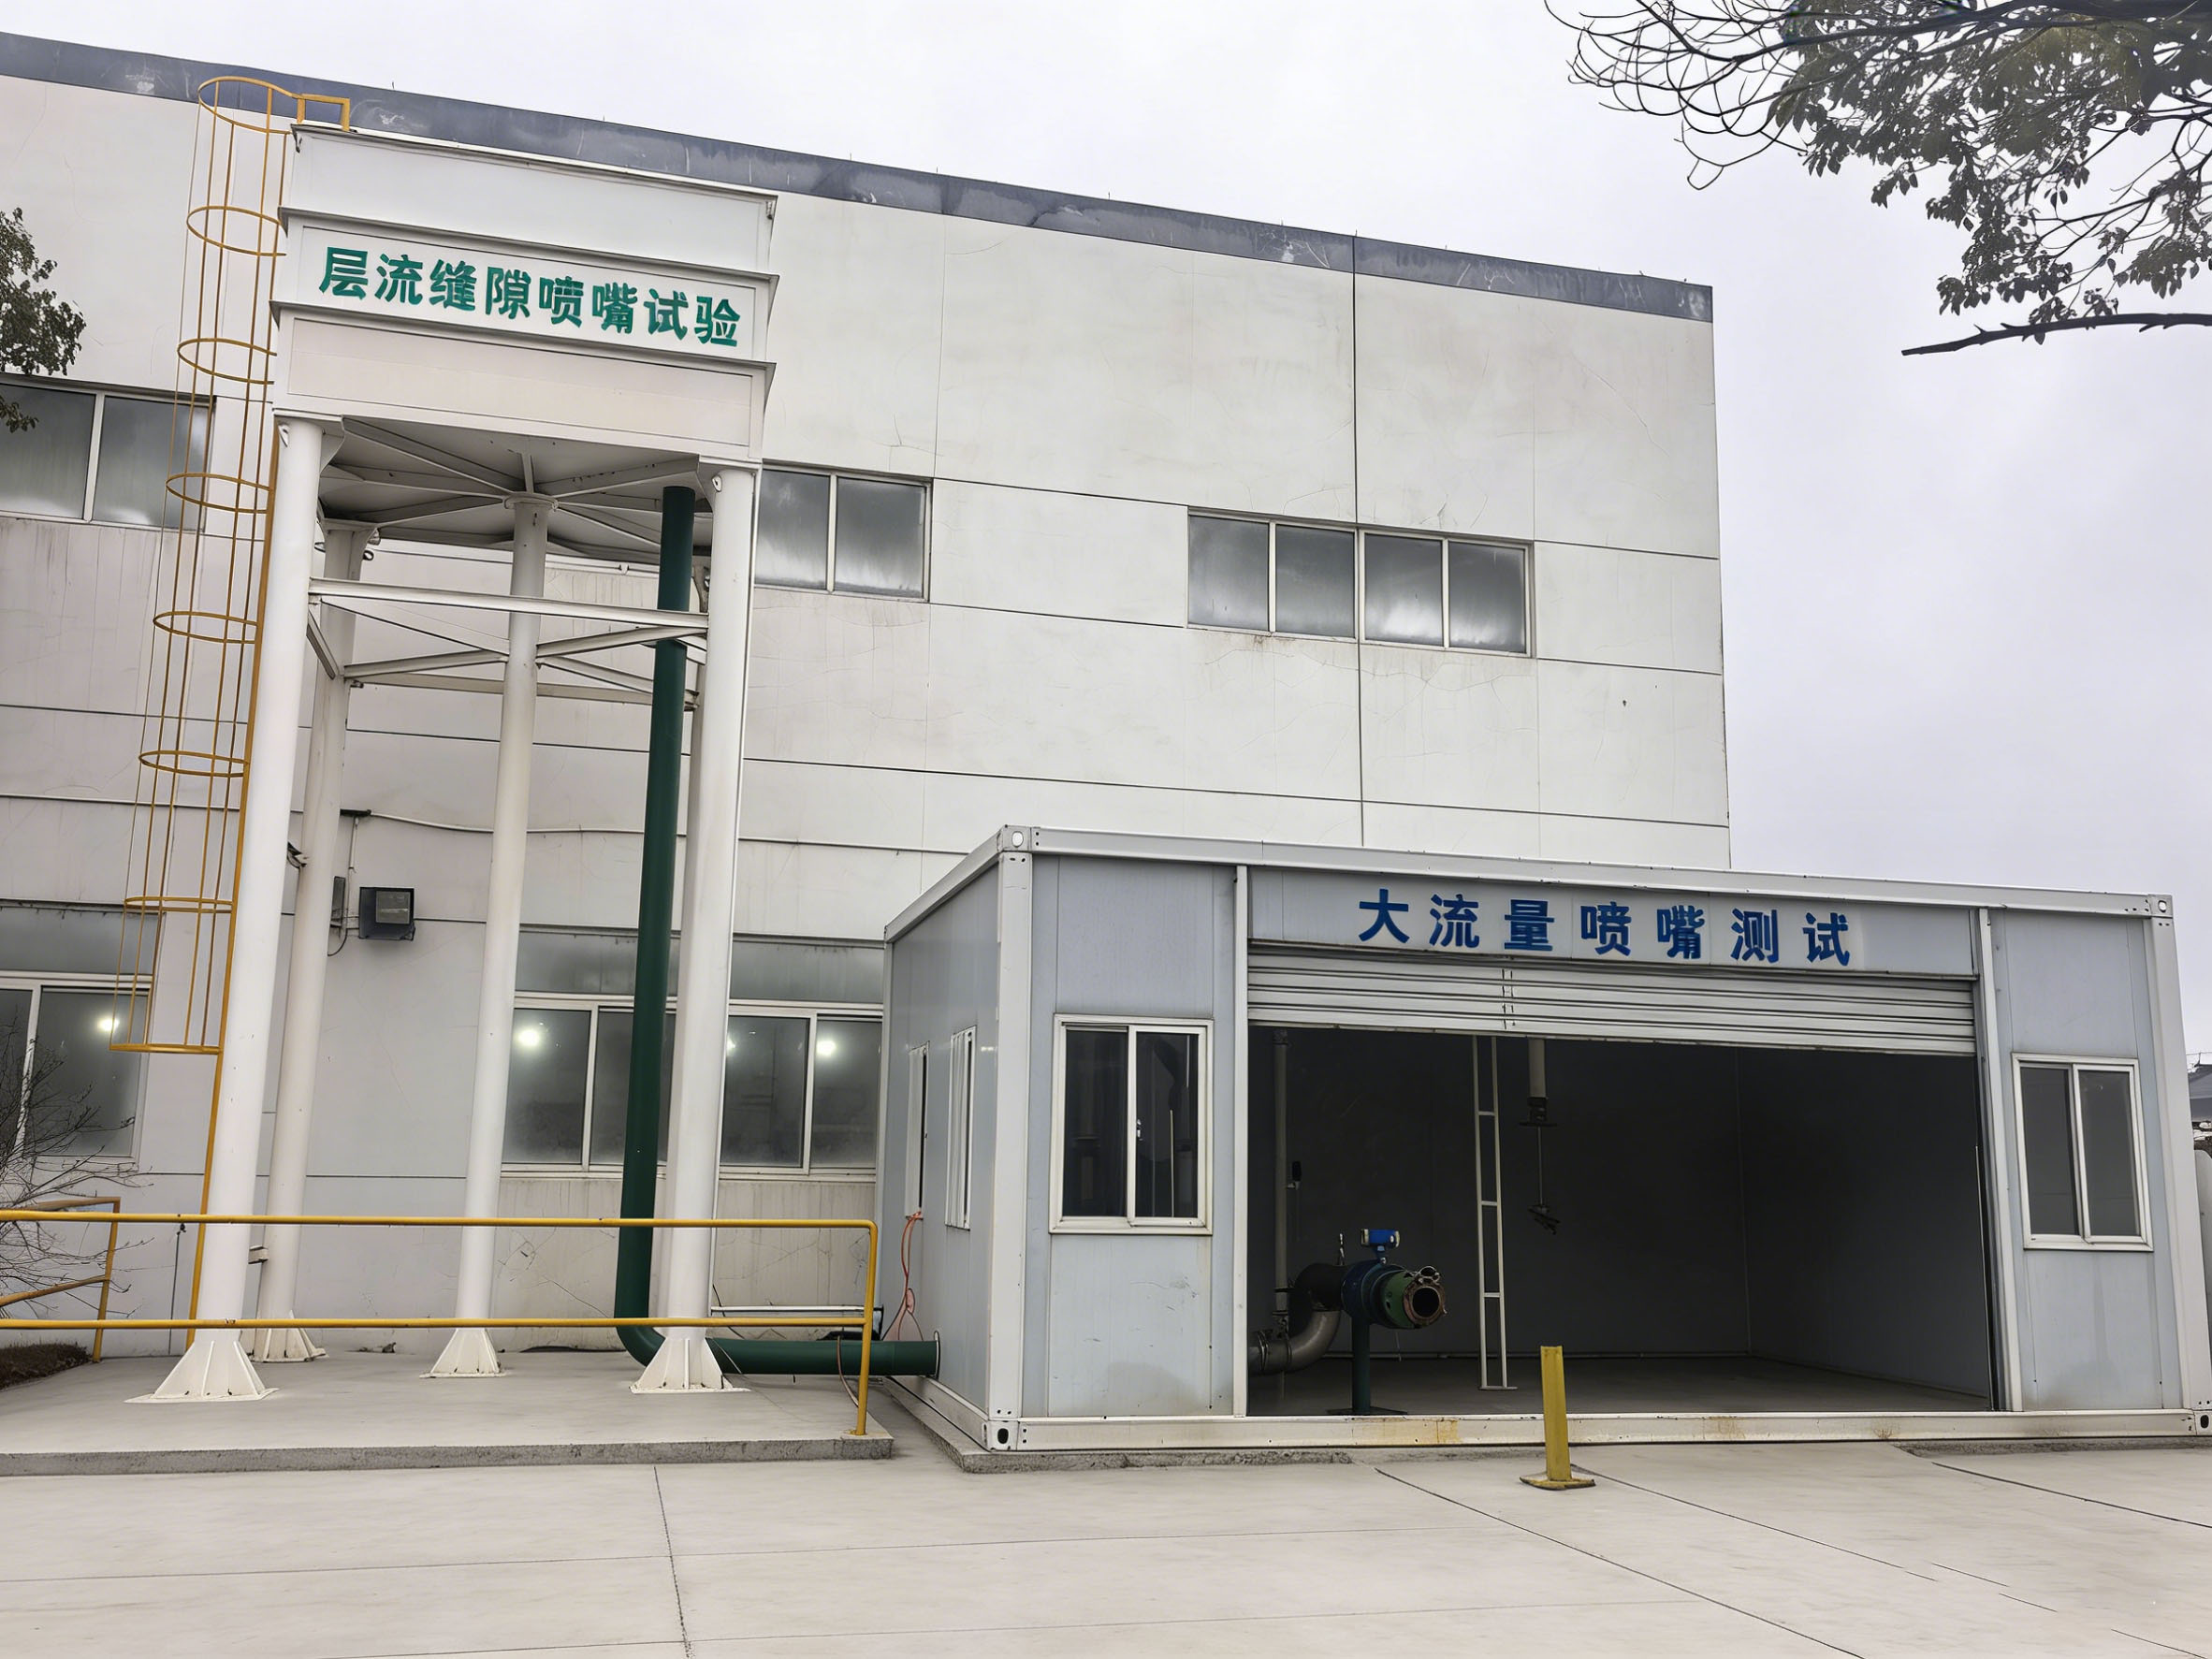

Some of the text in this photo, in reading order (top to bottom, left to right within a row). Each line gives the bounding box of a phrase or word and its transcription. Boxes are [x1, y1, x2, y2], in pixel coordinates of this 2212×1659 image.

[318, 246, 741, 347] 层流缝隙喷嘴试验
[1359, 888, 1850, 967] 大流量喷嘴测试
